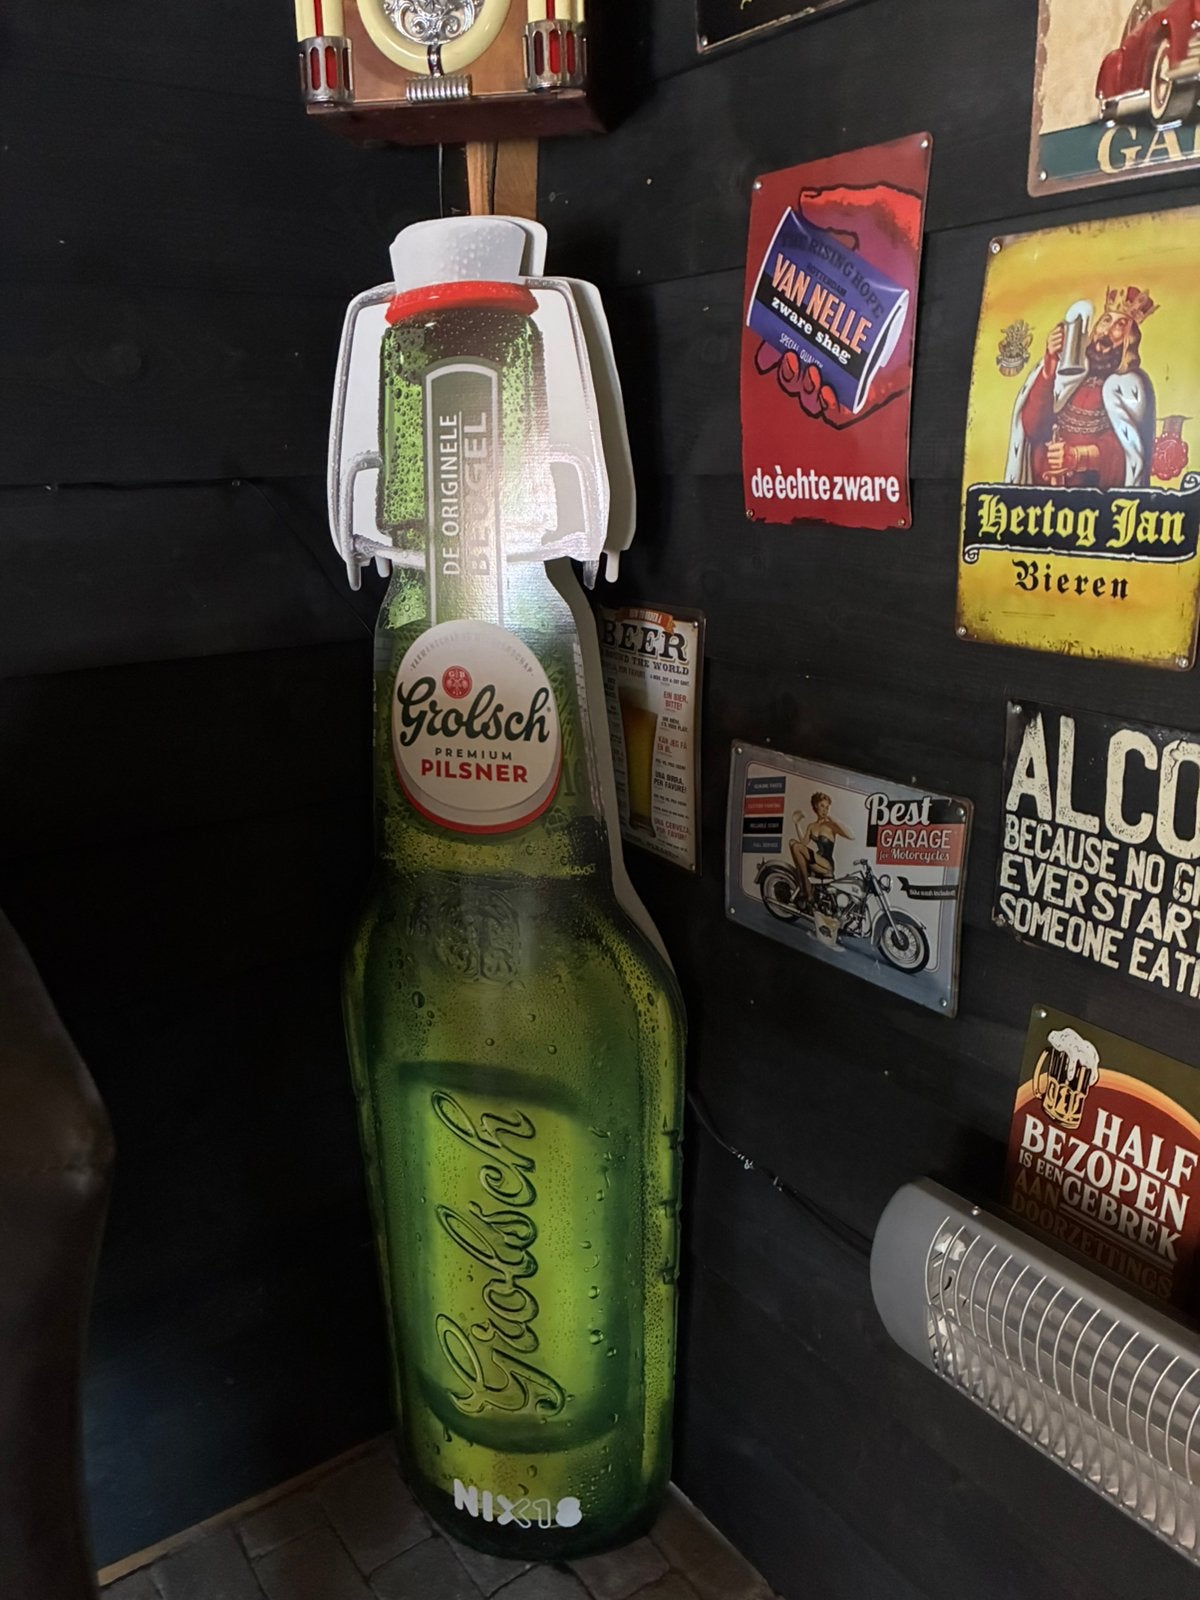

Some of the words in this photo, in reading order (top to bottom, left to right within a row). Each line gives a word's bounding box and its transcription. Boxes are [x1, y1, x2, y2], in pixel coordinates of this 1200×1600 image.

[1097, 124, 1200, 174] GA
[771, 253, 811, 307] VAN
[805, 283, 873, 354] NELLE
[810, 240, 854, 277] RISING
[851, 271, 885, 319] HOPE
[771, 297, 814, 335] zware
[815, 330, 852, 365] shag
[778, 332, 800, 353] SPECIAL
[439, 414, 460, 537] ORIGINELE
[751, 467, 774, 499] de
[774, 465, 831, 501] èchte
[832, 475, 901, 503] zware
[977, 494, 1100, 547] Hertog
[1105, 498, 1187, 548] Jan
[443, 547, 461, 575] DE
[1012, 559, 1130, 601] Bieren
[603, 620, 688, 661] BEER
[632, 656, 650, 668] THE
[652, 661, 690, 675] WORLD
[397, 676, 551, 747] Grolsch
[421, 759, 529, 783] PILSNER
[435, 748, 512, 761] PREMIUM
[864, 791, 932, 826] Best
[879, 851, 888, 861] for
[891, 849, 950, 864] Motorcycles
[880, 829, 953, 849] GARAGE
[1003, 813, 1120, 882] BECAUSE
[1124, 847, 1166, 894] NO
[1000, 851, 1090, 914] EVER
[1000, 892, 1124, 970] SOMEONE
[1019, 1149, 1033, 1170] IS
[1036, 1158, 1065, 1187] EEN
[1021, 1114, 1190, 1233] BEZOPEN
[1092, 1107, 1199, 1189] HALF
[1013, 1168, 1060, 1211] AAN
[1011, 1190, 1175, 1298] DOORZETTINGS
[1062, 1176, 1183, 1262] GEBREK
[431, 1088, 567, 1417] Grolsch
[453, 1478, 583, 1530] NIX18
